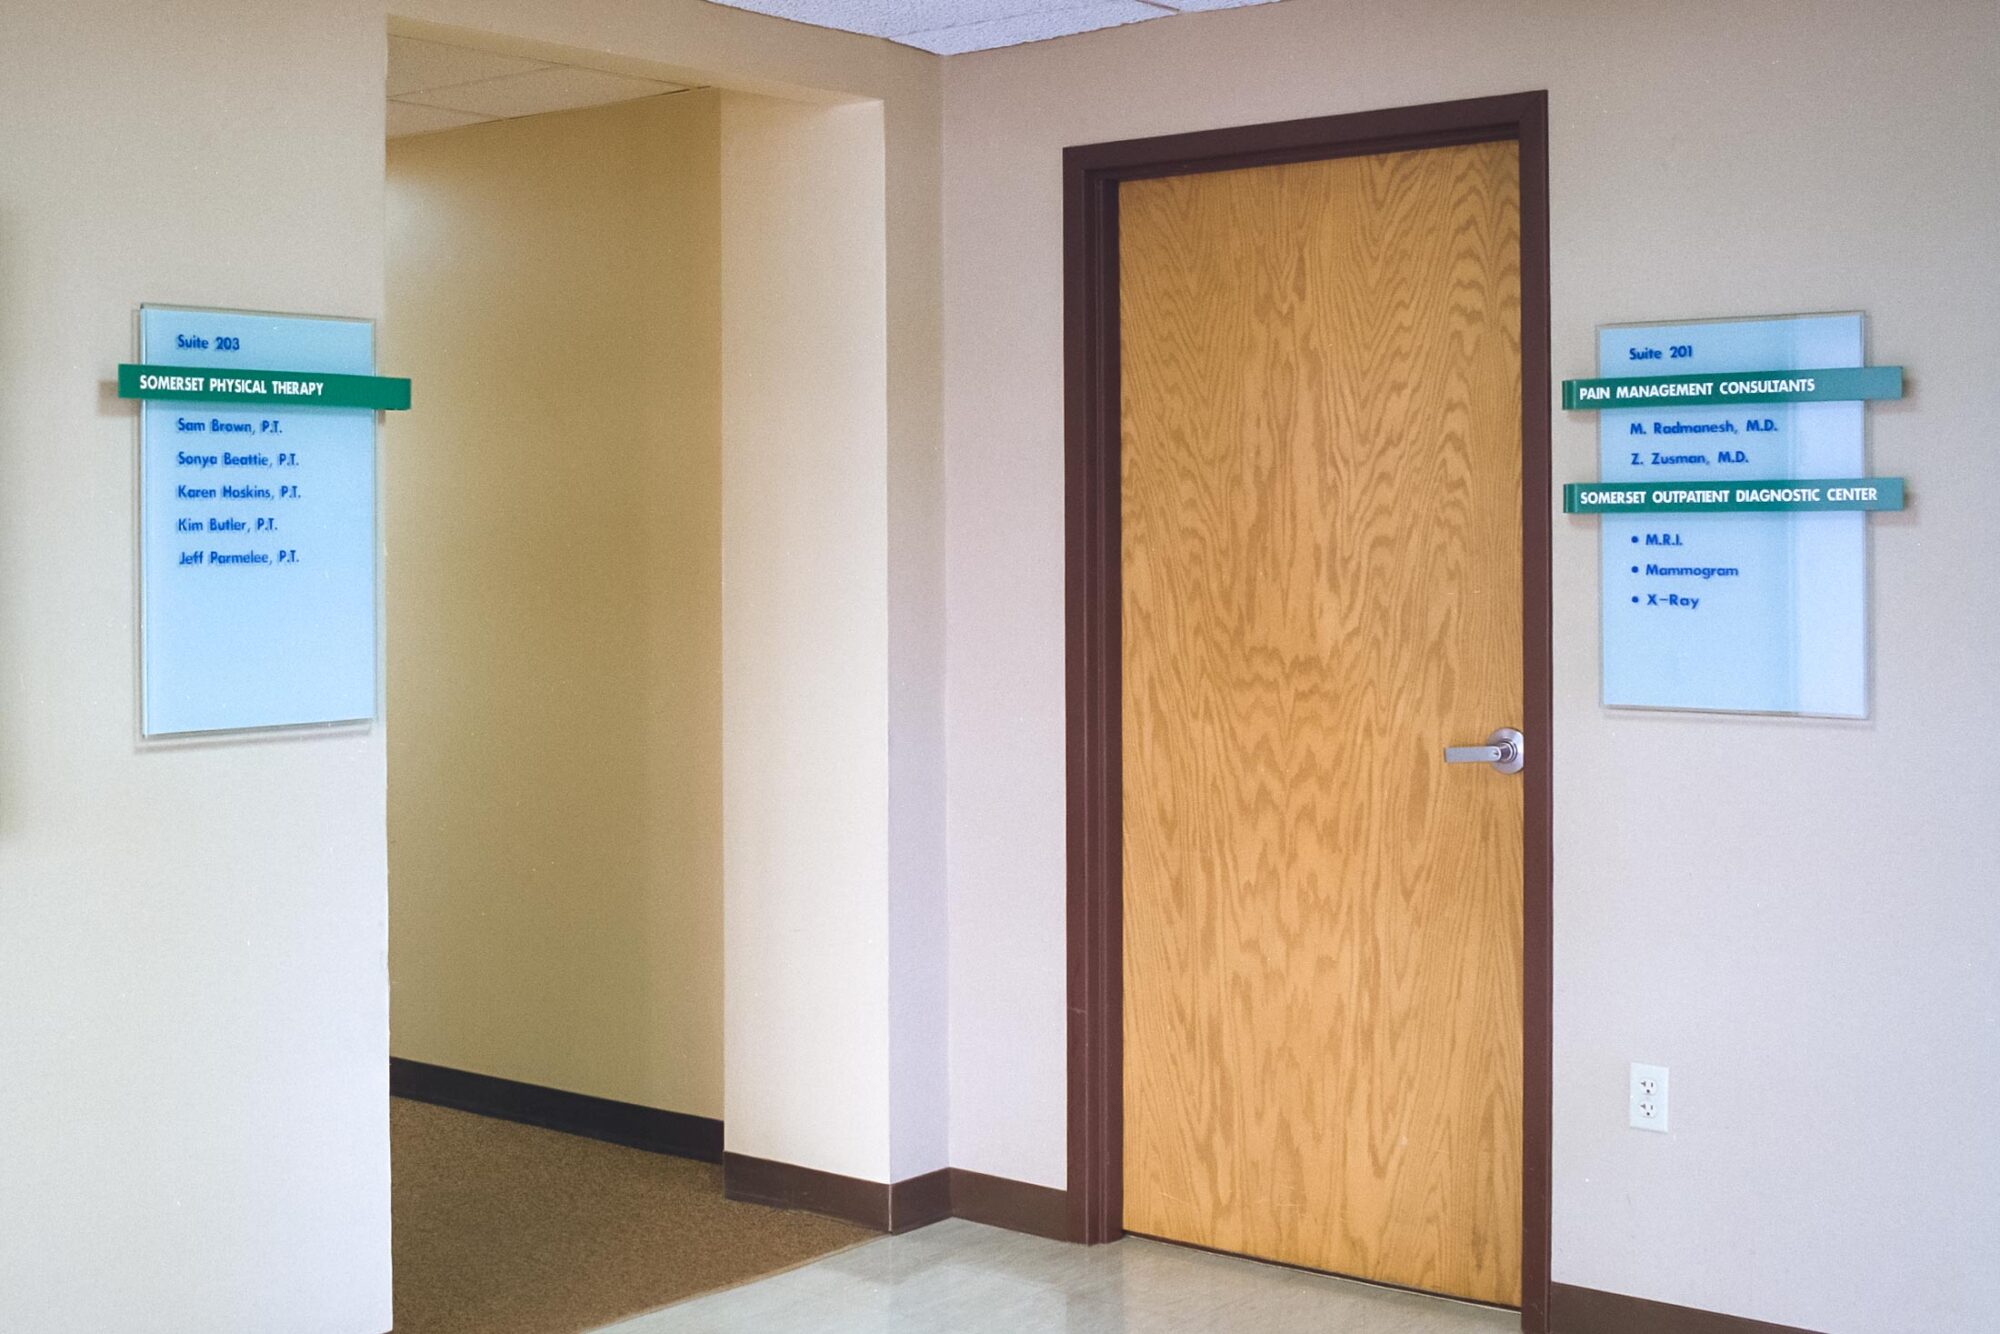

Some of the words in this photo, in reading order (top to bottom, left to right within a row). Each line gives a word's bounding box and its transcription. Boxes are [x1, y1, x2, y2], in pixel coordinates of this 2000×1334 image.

[178, 335, 208, 349] Suite
[216, 337, 240, 350] 203
[1630, 347, 1662, 360] Suite
[1670, 345, 1693, 358] 201
[140, 375, 204, 391] SOMERSET
[210, 378, 266, 394] PHYSICAL
[272, 381, 323, 396] THERAPY
[1580, 387, 1610, 400] PAIN
[1616, 383, 1713, 398] MANAGEMENT
[1720, 379, 1815, 395] CONSULTANTS
[178, 418, 205, 431] Sam
[212, 419, 255, 435] Brown,
[262, 421, 282, 433] P.T.
[1630, 423, 1646, 435] M.
[1654, 420, 1738, 434] Radmanesh,
[1746, 419, 1778, 432] M.D.
[178, 452, 217, 468] Sonya
[224, 453, 272, 468] Beattie,
[279, 454, 299, 466] P.T.
[1631, 453, 1643, 465] Z.
[1651, 452, 1710, 466] Zusman,
[1718, 451, 1749, 463] M.D.
[178, 485, 216, 498] Karen
[223, 486, 275, 500] Hoskins,
[281, 486, 301, 498] P.T.
[1580, 491, 1646, 504] SOMERSET
[1652, 490, 1730, 503] OUTPATIENT
[1736, 489, 1820, 502] DIAGNOSTIC
[1827, 488, 1877, 501] CENTER
[178, 518, 203, 531] Kim
[210, 519, 251, 533] Butler,
[257, 519, 277, 531] P.T.
[1646, 534, 1683, 546] M.R.I.
[179, 551, 204, 565] Jeff
[210, 551, 272, 566] Parmelee,
[279, 551, 299, 563] P.T.
[1646, 564, 1739, 579] Mammogram
[1647, 594, 1699, 609] X-Ray
